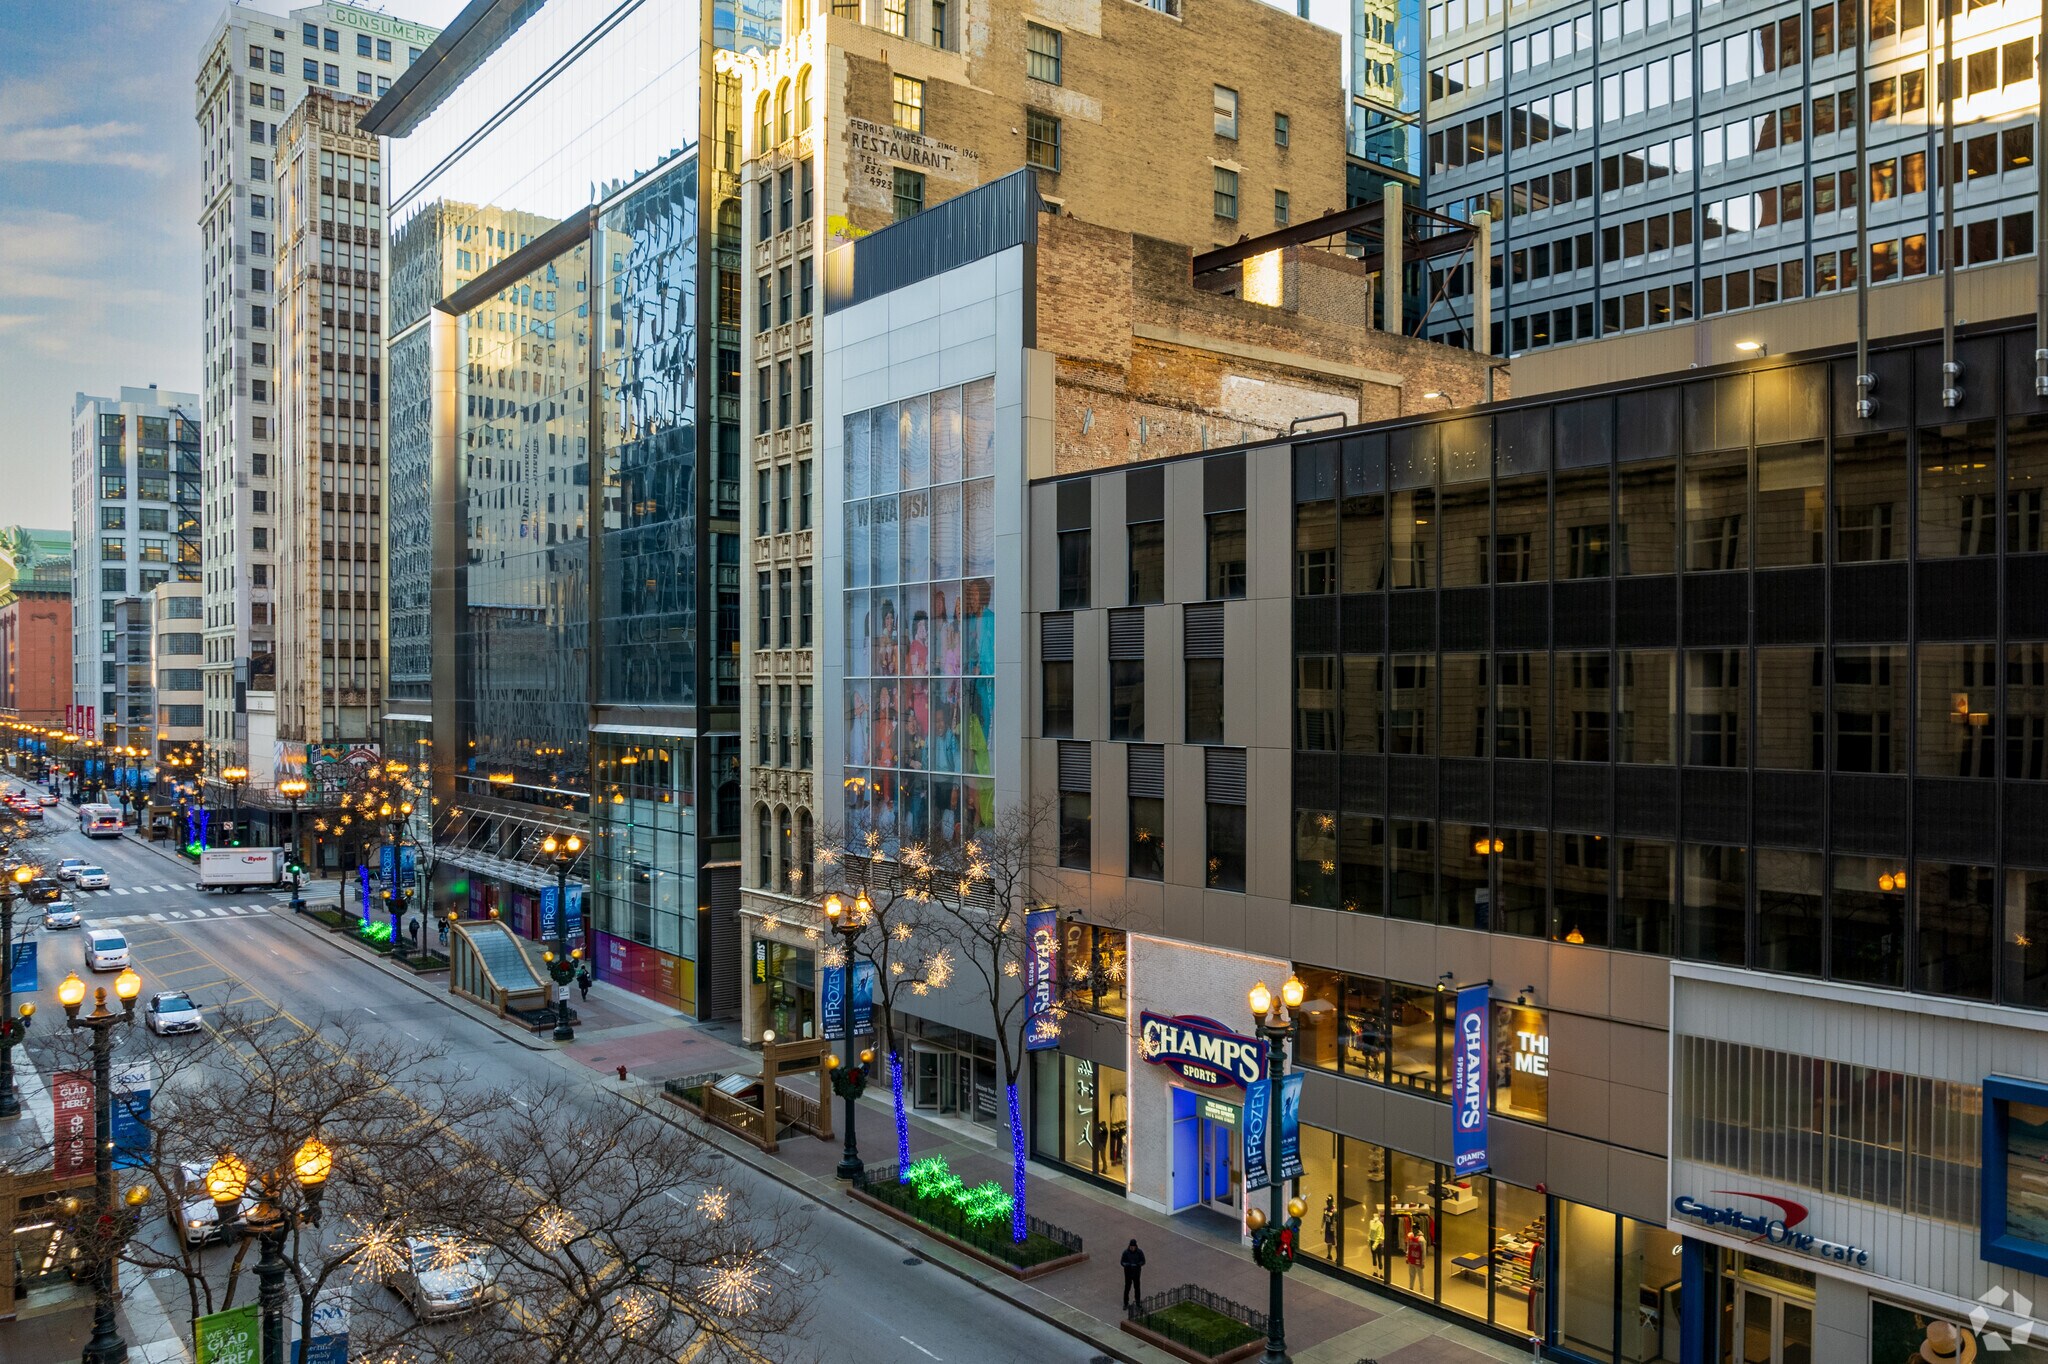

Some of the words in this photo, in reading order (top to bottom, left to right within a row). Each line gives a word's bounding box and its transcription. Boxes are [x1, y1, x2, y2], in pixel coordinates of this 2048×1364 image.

[336, 9, 437, 43] CONSUMERS
[937, 142, 958, 152] SINCE
[962, 148, 979, 159] 1964
[869, 177, 892, 190] 4923
[543, 889, 556, 925] FROZEN
[757, 941, 766, 982] SUBWAY
[1033, 929, 1050, 1014] CHAMPS
[825, 965, 842, 1018] FROZEN
[1144, 1020, 1260, 1083] CHAMPS
[1183, 1064, 1217, 1084] SPORTS
[1456, 1056, 1464, 1090] SPORTS
[1461, 1013, 1482, 1128] CHAMPS
[60, 1086, 87, 1097] GLAD
[1247, 1085, 1265, 1157] FROZEN
[1456, 1150, 1486, 1166] CHAMPS
[1674, 1196, 1768, 1235] Capital
[1766, 1219, 1815, 1251] One
[311, 1307, 344, 1321] SNA
[207, 1332, 248, 1351] GLAD
